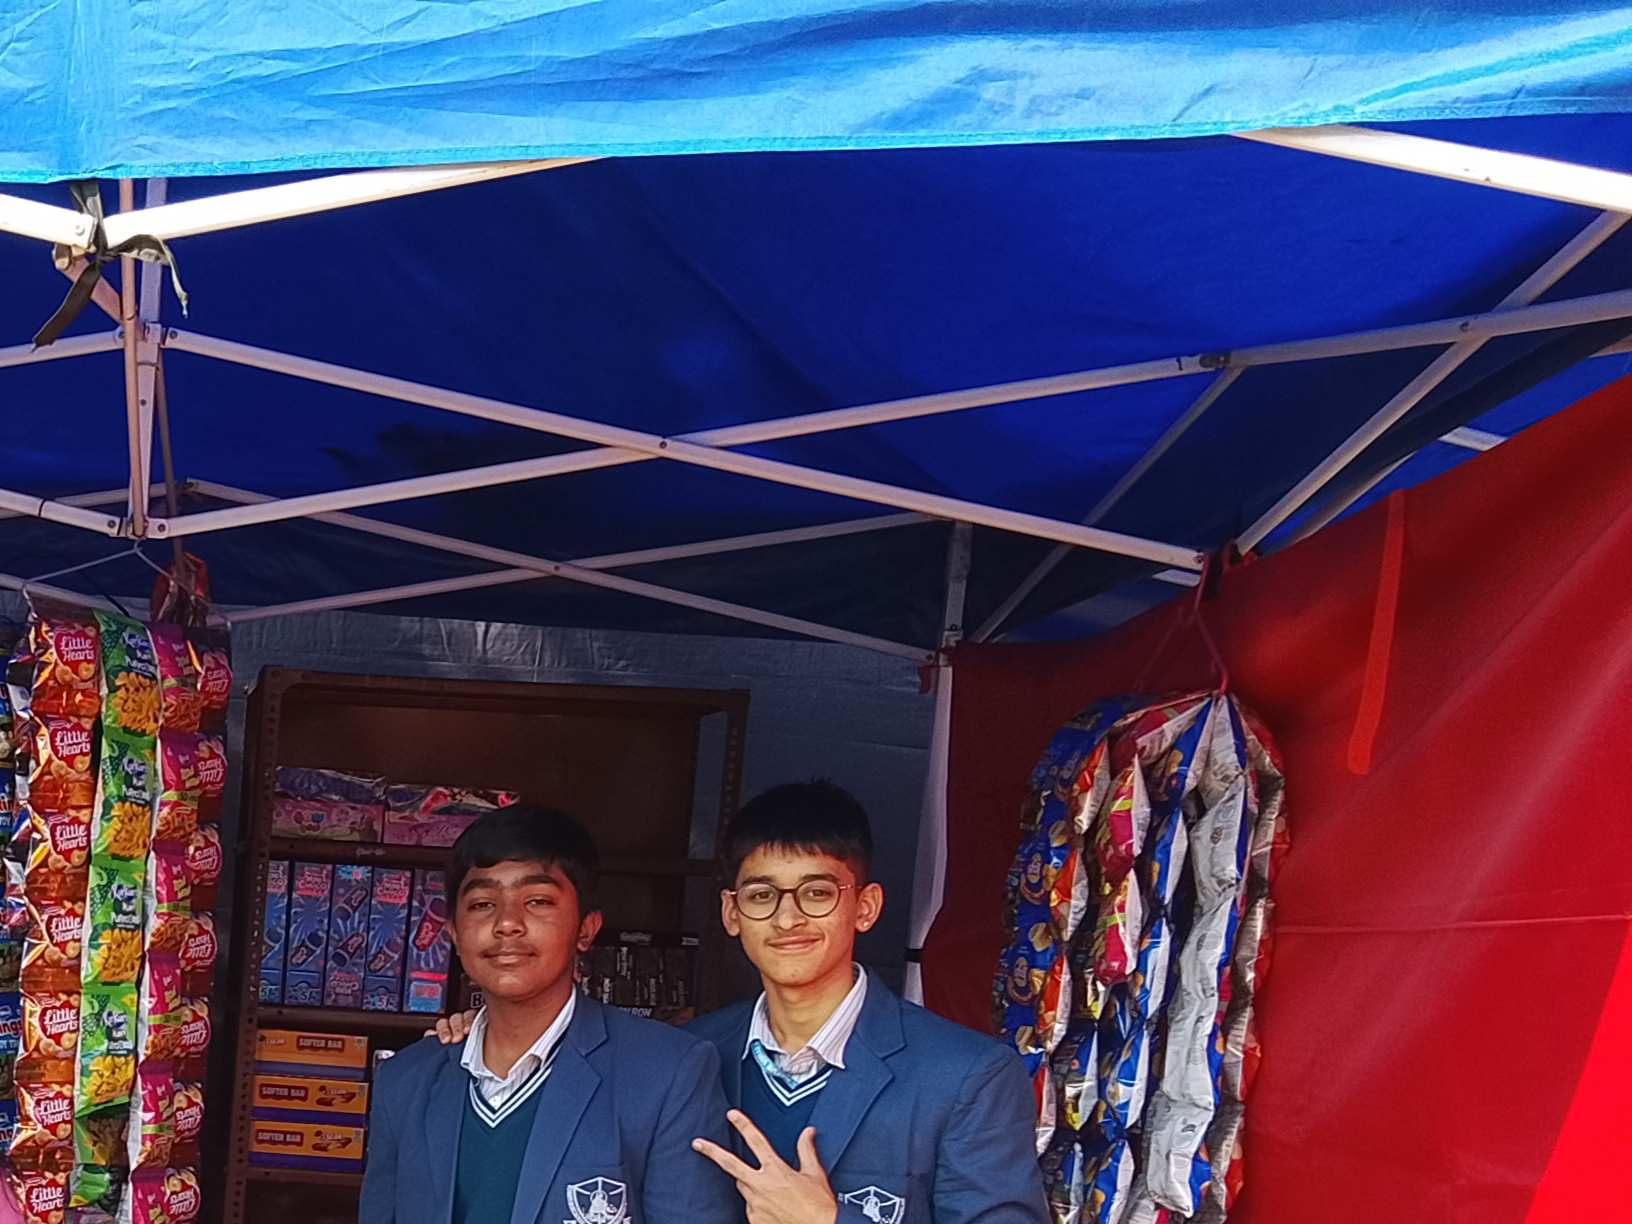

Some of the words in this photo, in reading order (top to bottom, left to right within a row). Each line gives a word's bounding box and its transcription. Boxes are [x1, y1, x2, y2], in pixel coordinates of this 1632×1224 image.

[60, 635, 93, 650] Little
[62, 649, 95, 662] Hearts
[55, 731, 90, 746] Little
[57, 742, 91, 757] Hearts
[55, 825, 88, 841] Little
[57, 836, 88, 852] Hearts
[44, 1009, 78, 1025] Little
[46, 1020, 78, 1035] Hearts
[38, 1098, 72, 1114] Little
[40, 1110, 72, 1126] Hearts
[31, 1186, 64, 1203] Little
